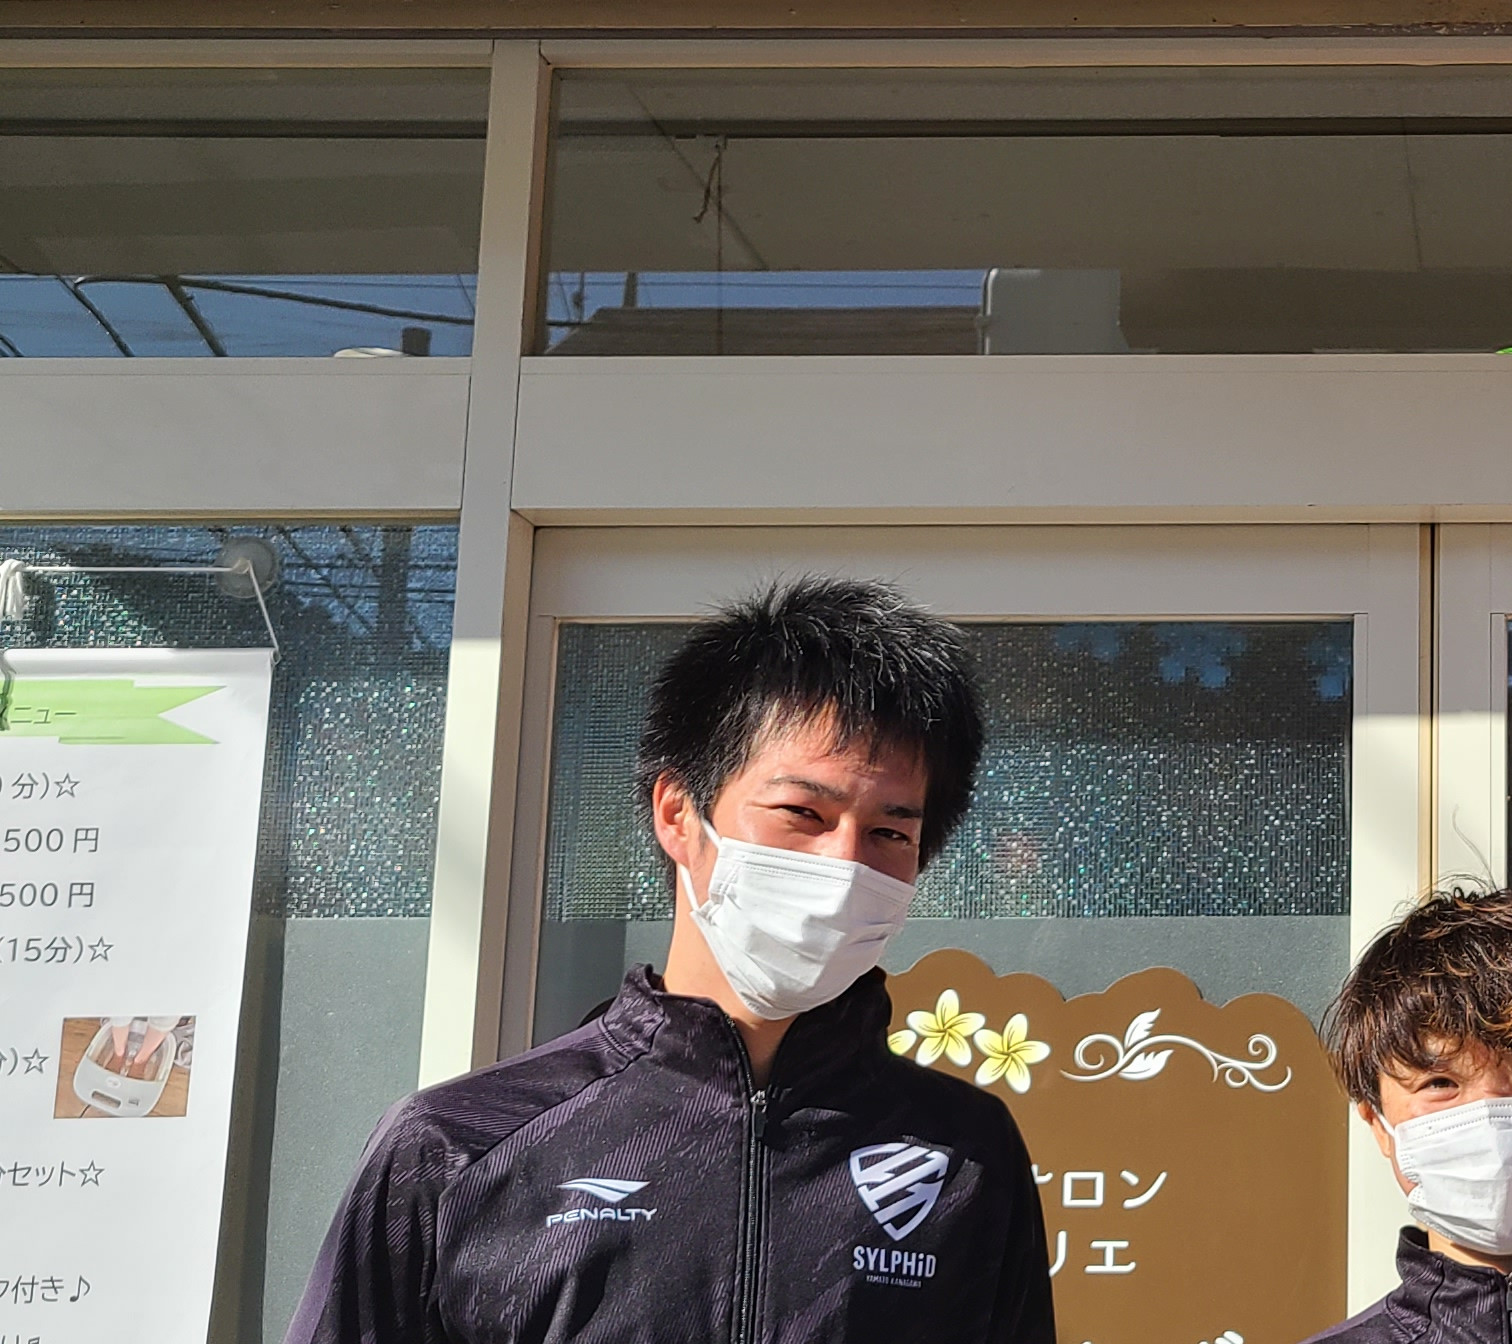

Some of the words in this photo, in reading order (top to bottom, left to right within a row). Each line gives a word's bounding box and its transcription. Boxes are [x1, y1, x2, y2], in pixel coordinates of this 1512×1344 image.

[0, 704, 77, 730] ニュー
[0, 1160, 76, 1188] セット
[545, 1207, 658, 1229] PENALTY
